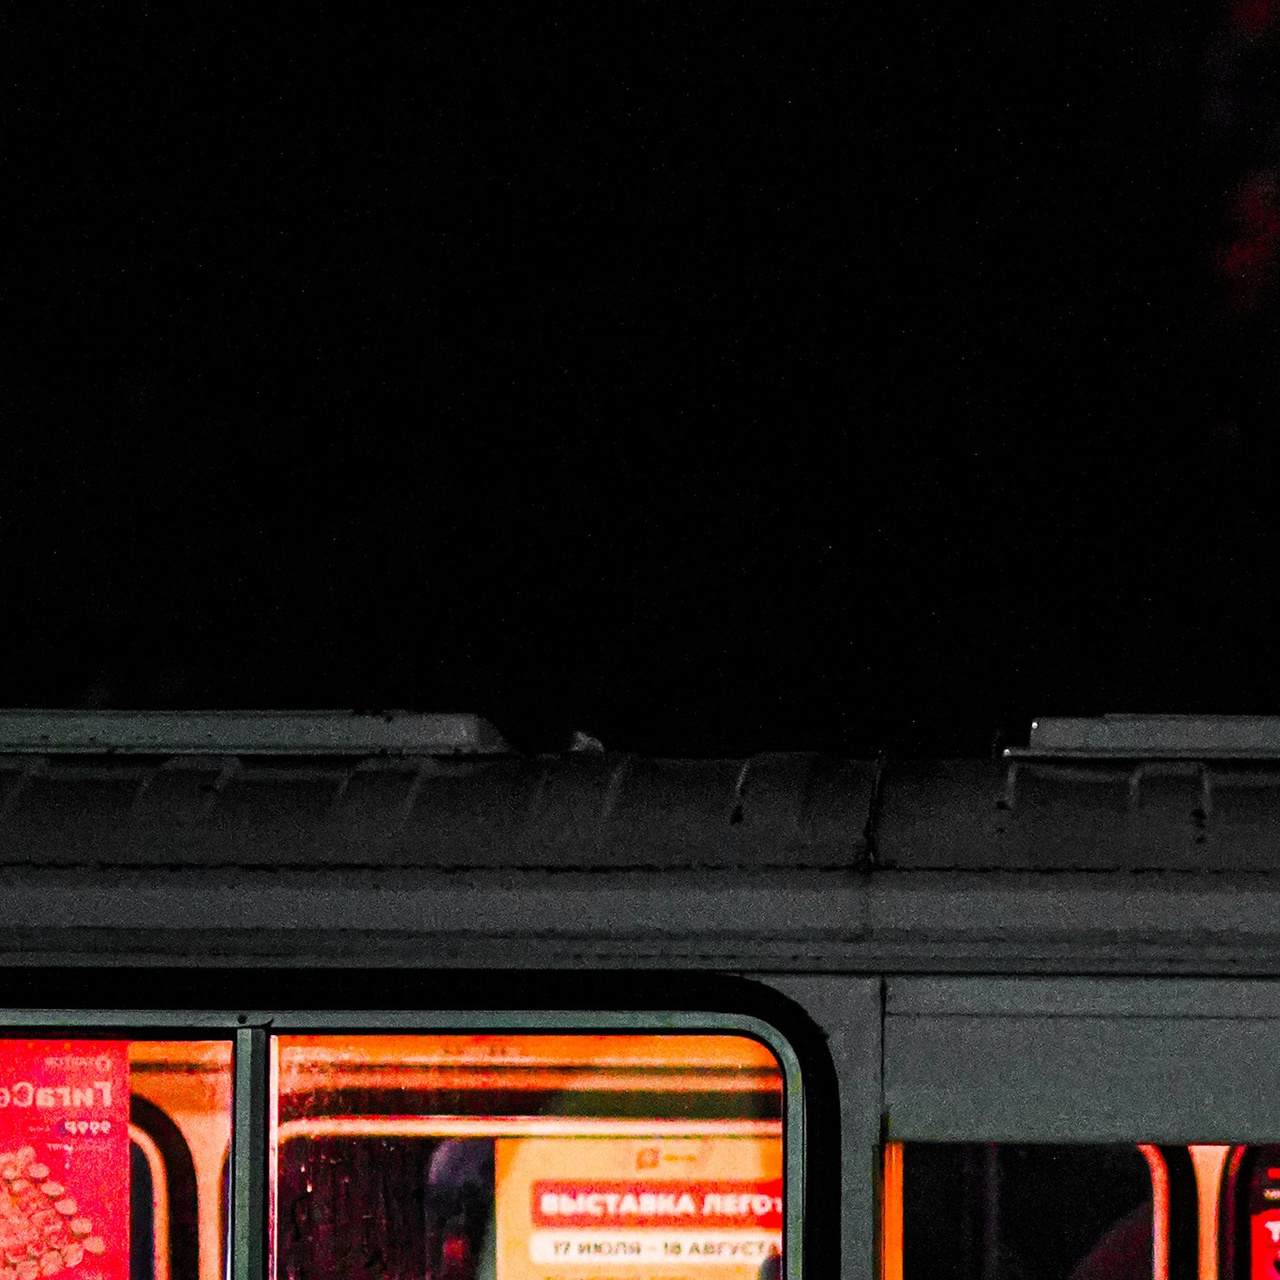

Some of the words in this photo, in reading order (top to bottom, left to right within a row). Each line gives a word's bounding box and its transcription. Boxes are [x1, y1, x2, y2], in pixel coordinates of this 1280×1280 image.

[541, 1194, 695, 1215] ВЫСТАВКА
[554, 1241, 570, 1255] 17
[578, 1241, 641, 1255] ИЮЛЯ
